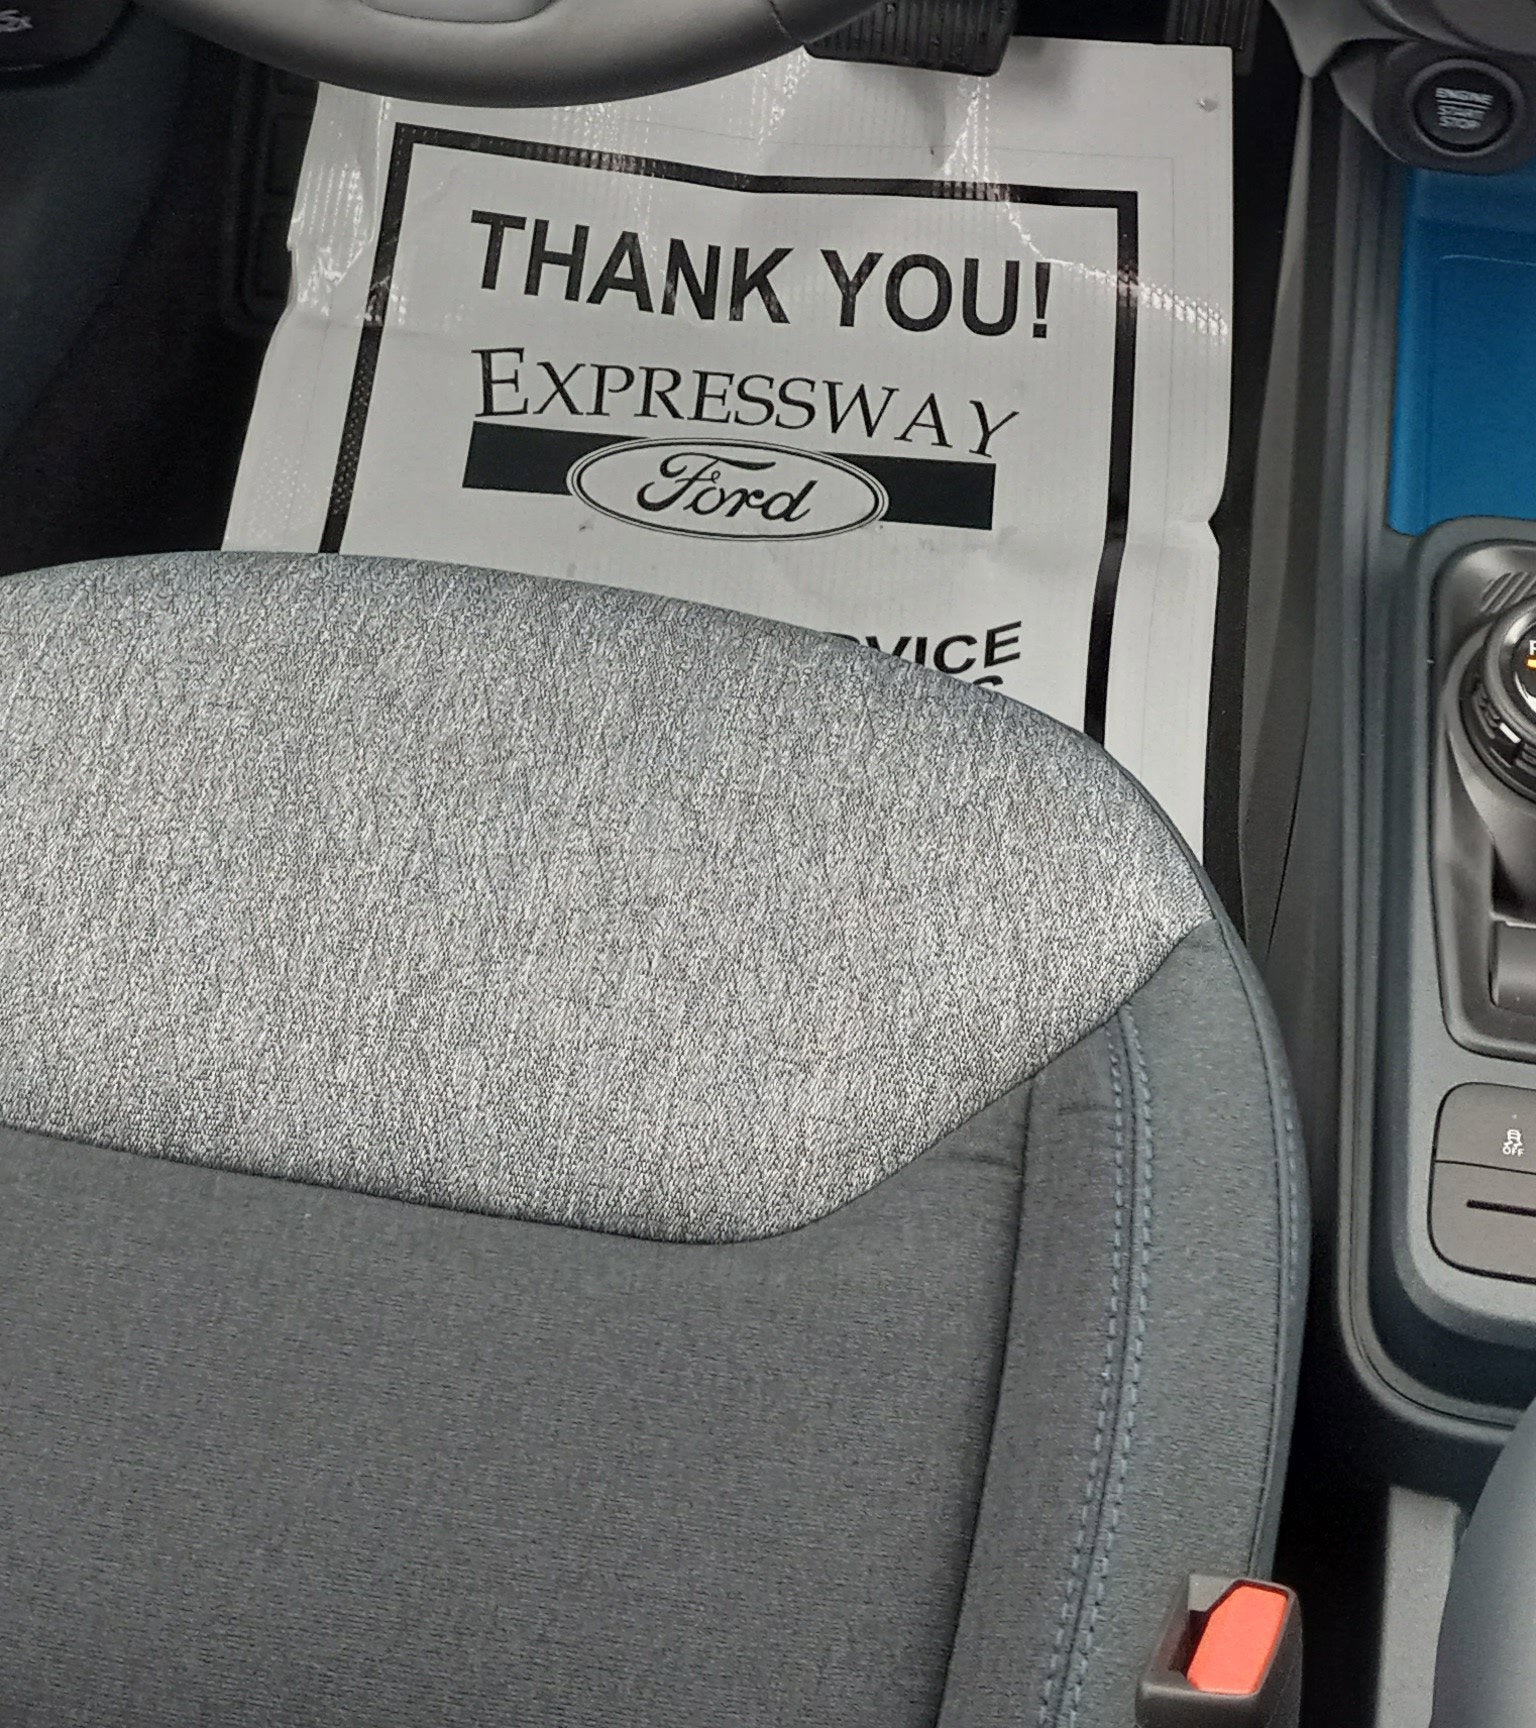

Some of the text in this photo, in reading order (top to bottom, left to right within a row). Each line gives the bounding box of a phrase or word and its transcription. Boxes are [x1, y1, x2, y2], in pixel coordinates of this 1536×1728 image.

[1435, 87, 1494, 106] ENGINE
[1438, 115, 1482, 130] STOP
[470, 209, 1052, 341] THANK YOU!
[636, 451, 819, 524] Ford
[1502, 1146, 1524, 1158] OFF
